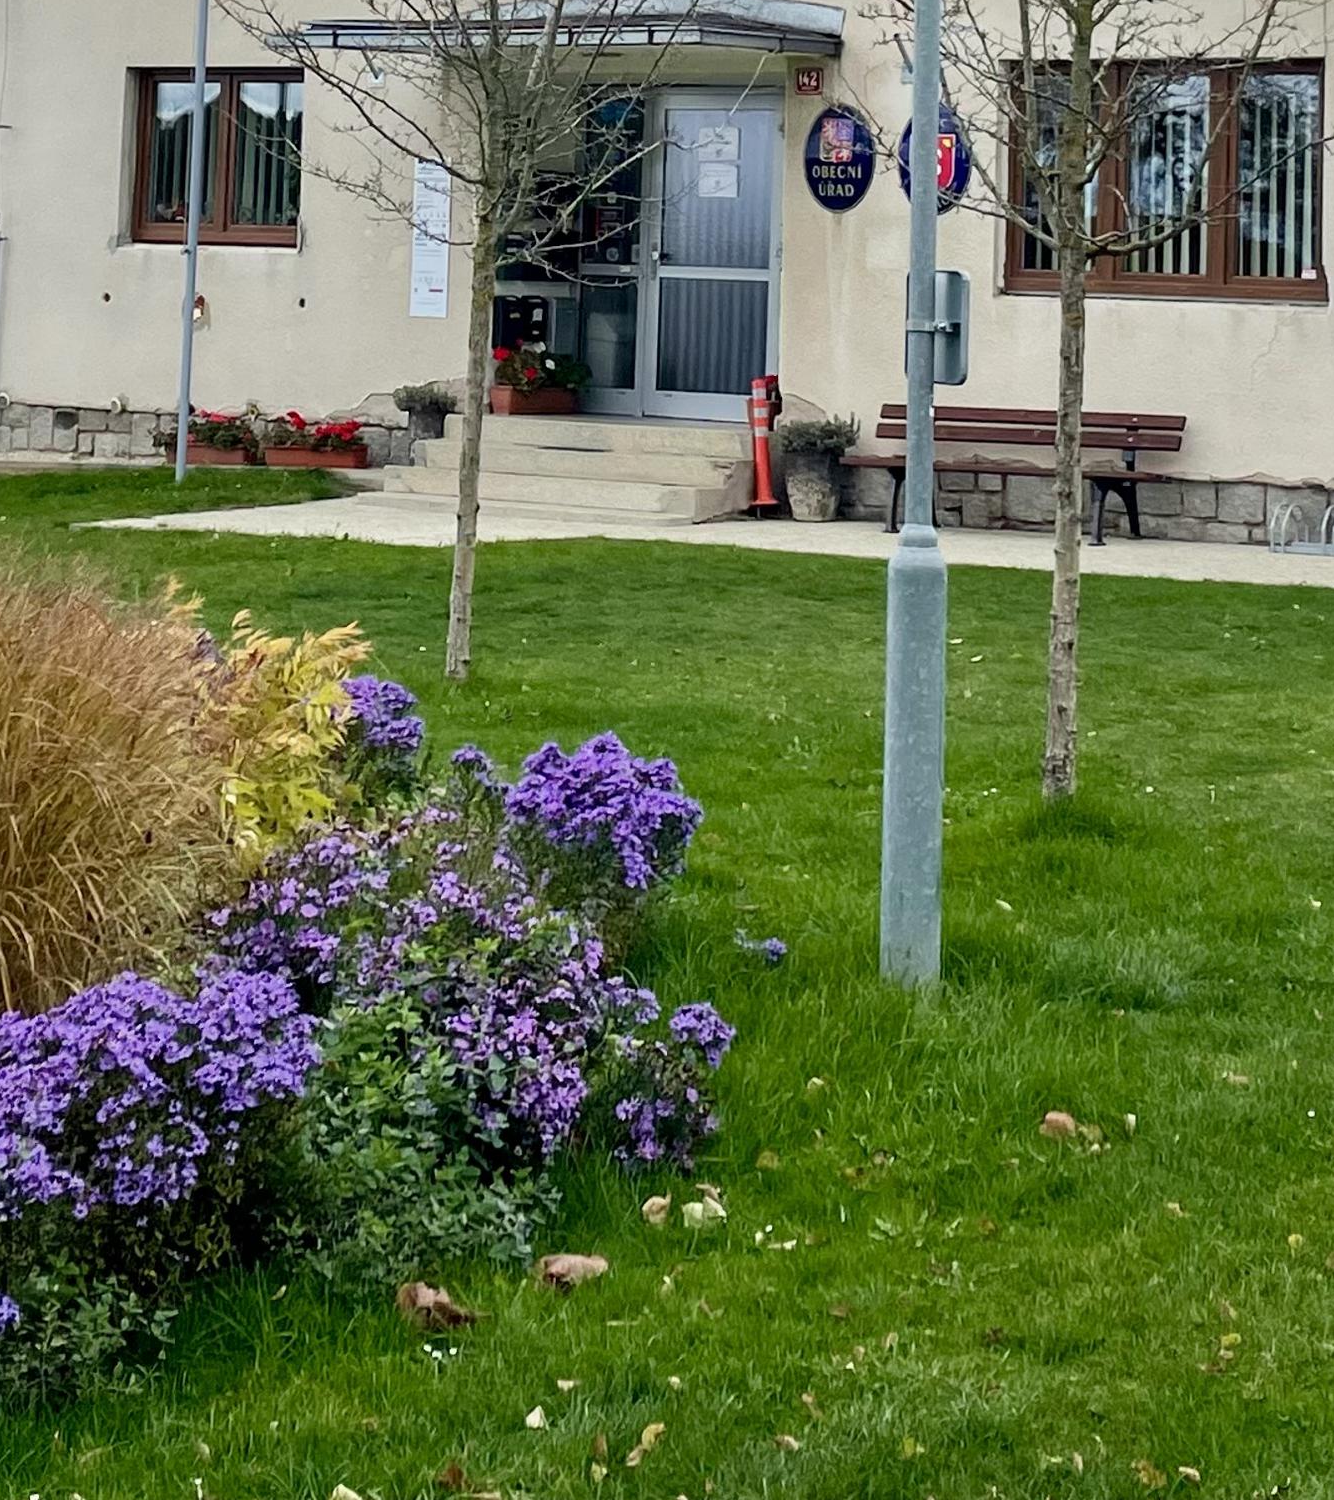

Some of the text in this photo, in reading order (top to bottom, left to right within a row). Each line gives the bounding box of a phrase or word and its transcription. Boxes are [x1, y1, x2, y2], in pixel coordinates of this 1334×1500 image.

[798, 71, 818, 87] 142
[811, 163, 862, 180] OBECNÍ
[818, 180, 855, 197] ÚŘAD
